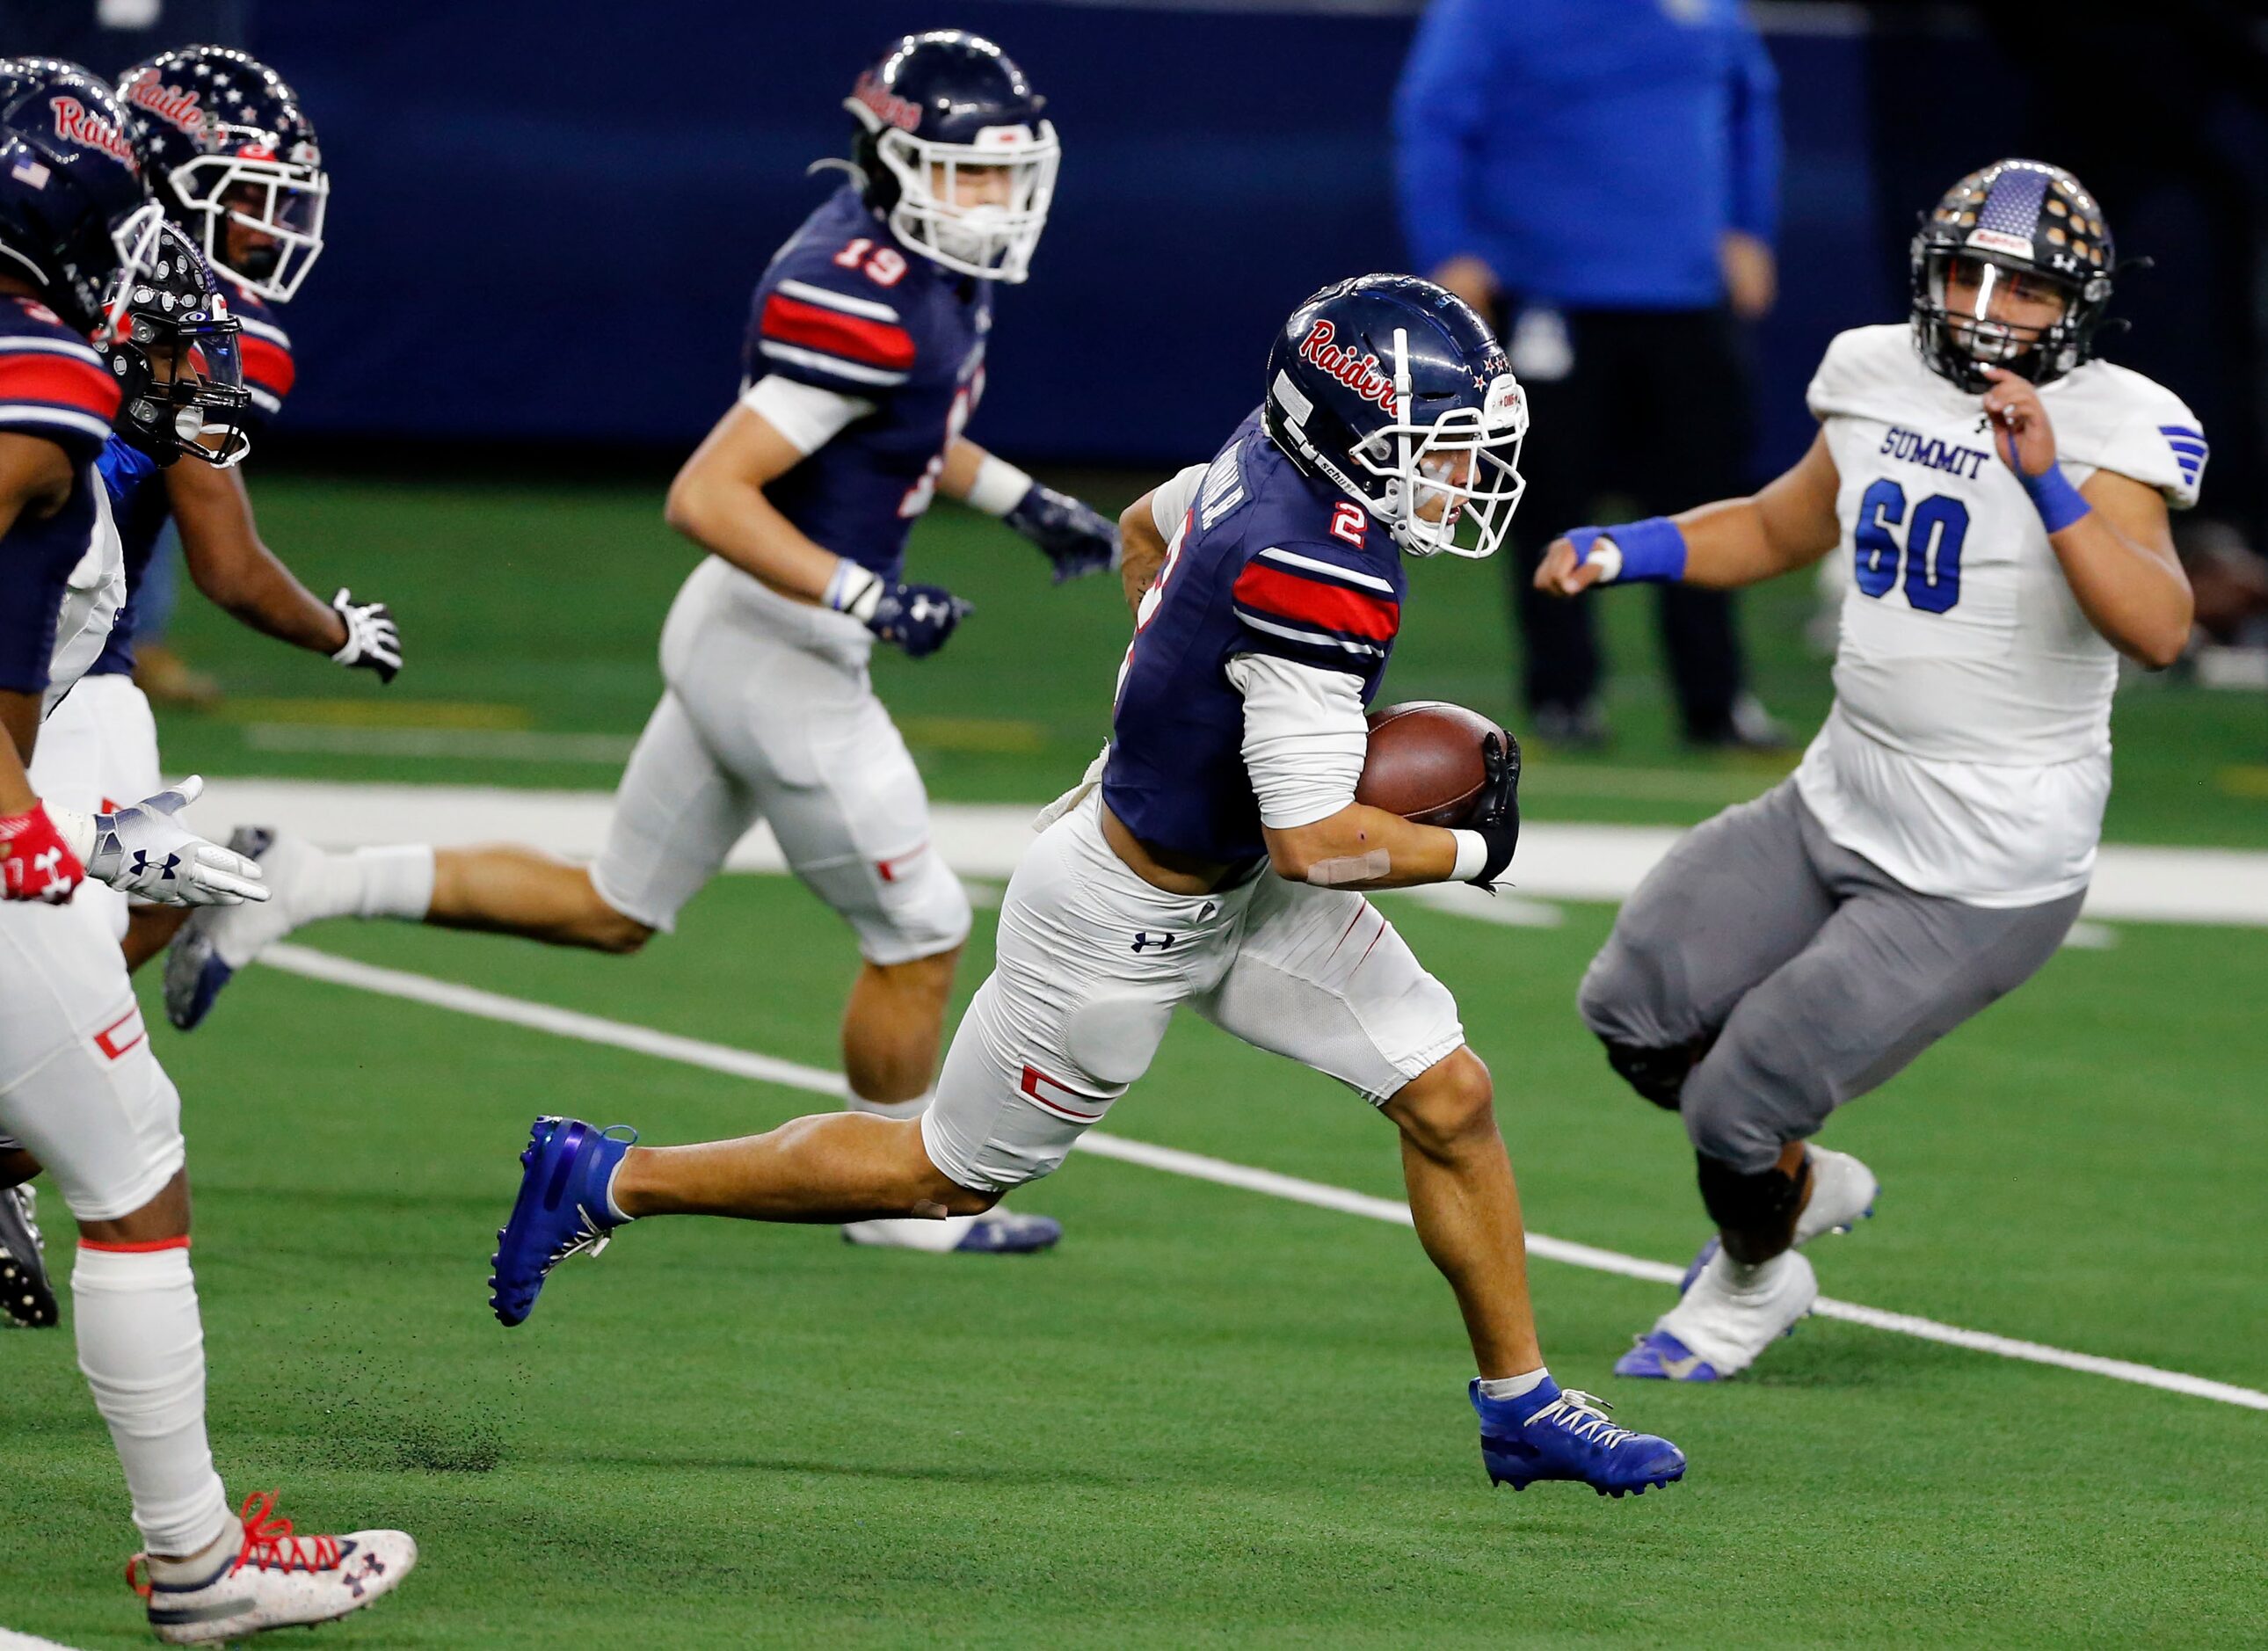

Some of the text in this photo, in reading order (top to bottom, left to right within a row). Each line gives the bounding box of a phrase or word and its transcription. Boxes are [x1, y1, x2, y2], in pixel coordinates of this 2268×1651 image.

[834, 237, 908, 287] 19
[1299, 319, 1399, 418] Raider
[1879, 425, 1989, 480] SUMMIT
[1330, 501, 1368, 549] 2
[1855, 477, 1970, 615] 60
